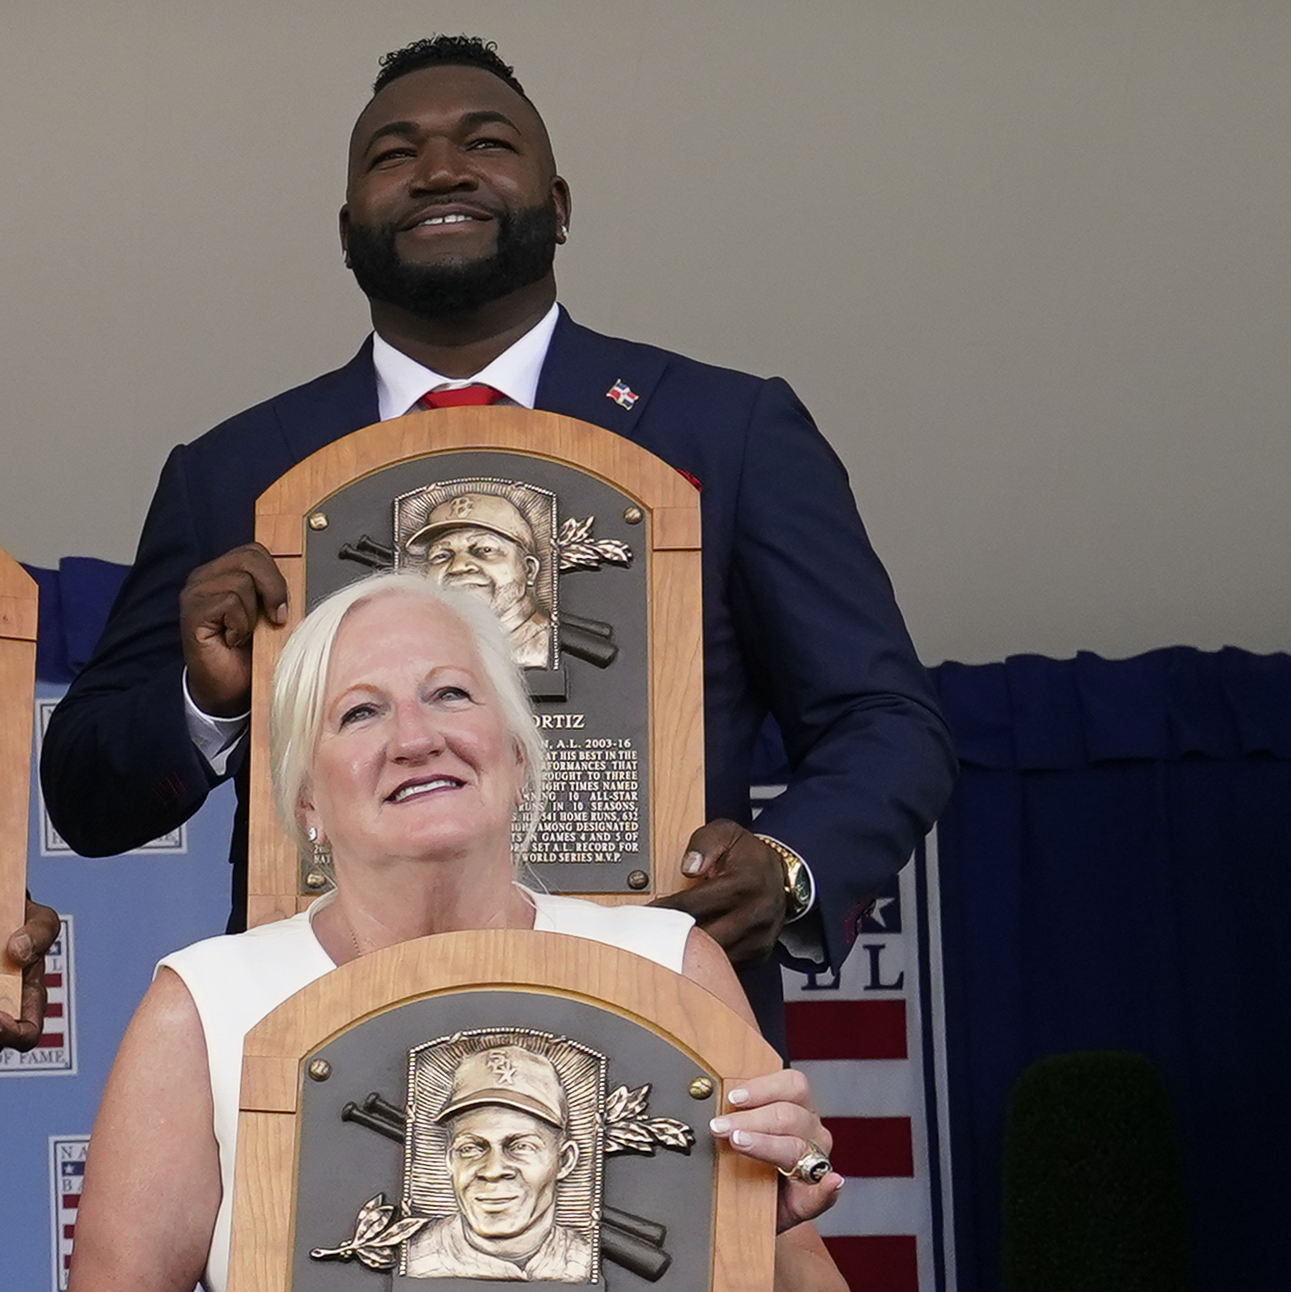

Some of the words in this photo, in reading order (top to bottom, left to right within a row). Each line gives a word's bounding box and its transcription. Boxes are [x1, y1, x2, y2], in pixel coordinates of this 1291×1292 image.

[560, 751, 576, 760] HIS
[579, 751, 603, 760] BEST
[605, 751, 616, 760] IN
[618, 751, 638, 760] THE
[19, 1050, 65, 1064] FAME
